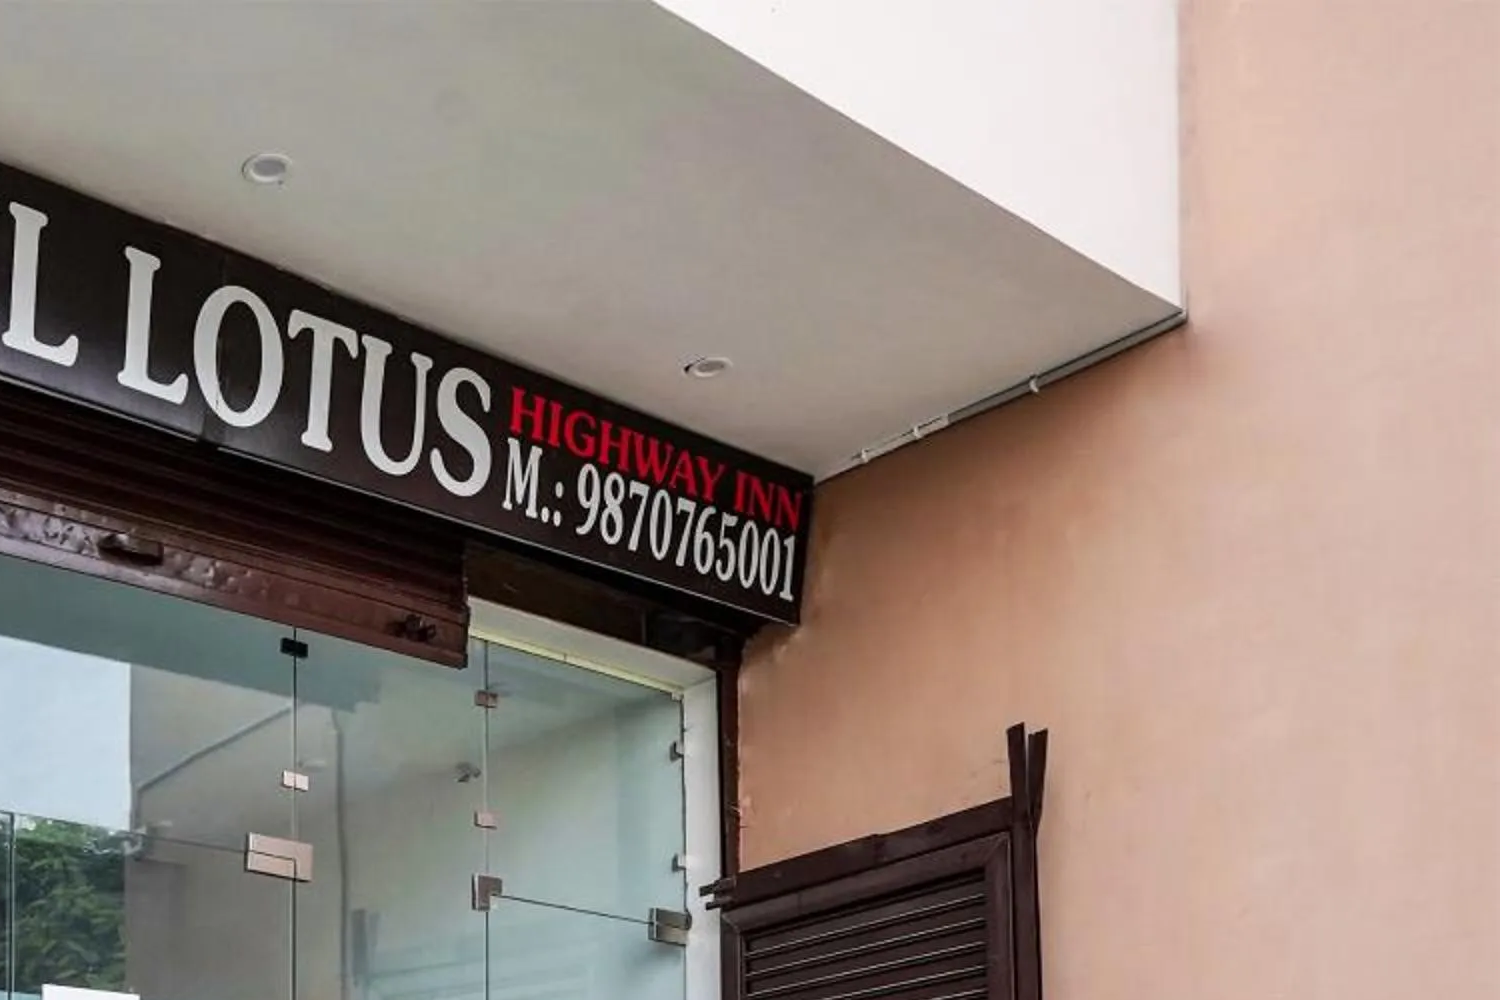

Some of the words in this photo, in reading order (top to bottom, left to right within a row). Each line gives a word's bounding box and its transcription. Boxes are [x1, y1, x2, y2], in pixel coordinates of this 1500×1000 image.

[117, 246, 492, 497] LOTUS
[502, 437, 564, 527] M.:
[575, 463, 796, 602] 9870765001
[509, 386, 725, 501] HIGHWAY
[734, 469, 801, 531] INN
